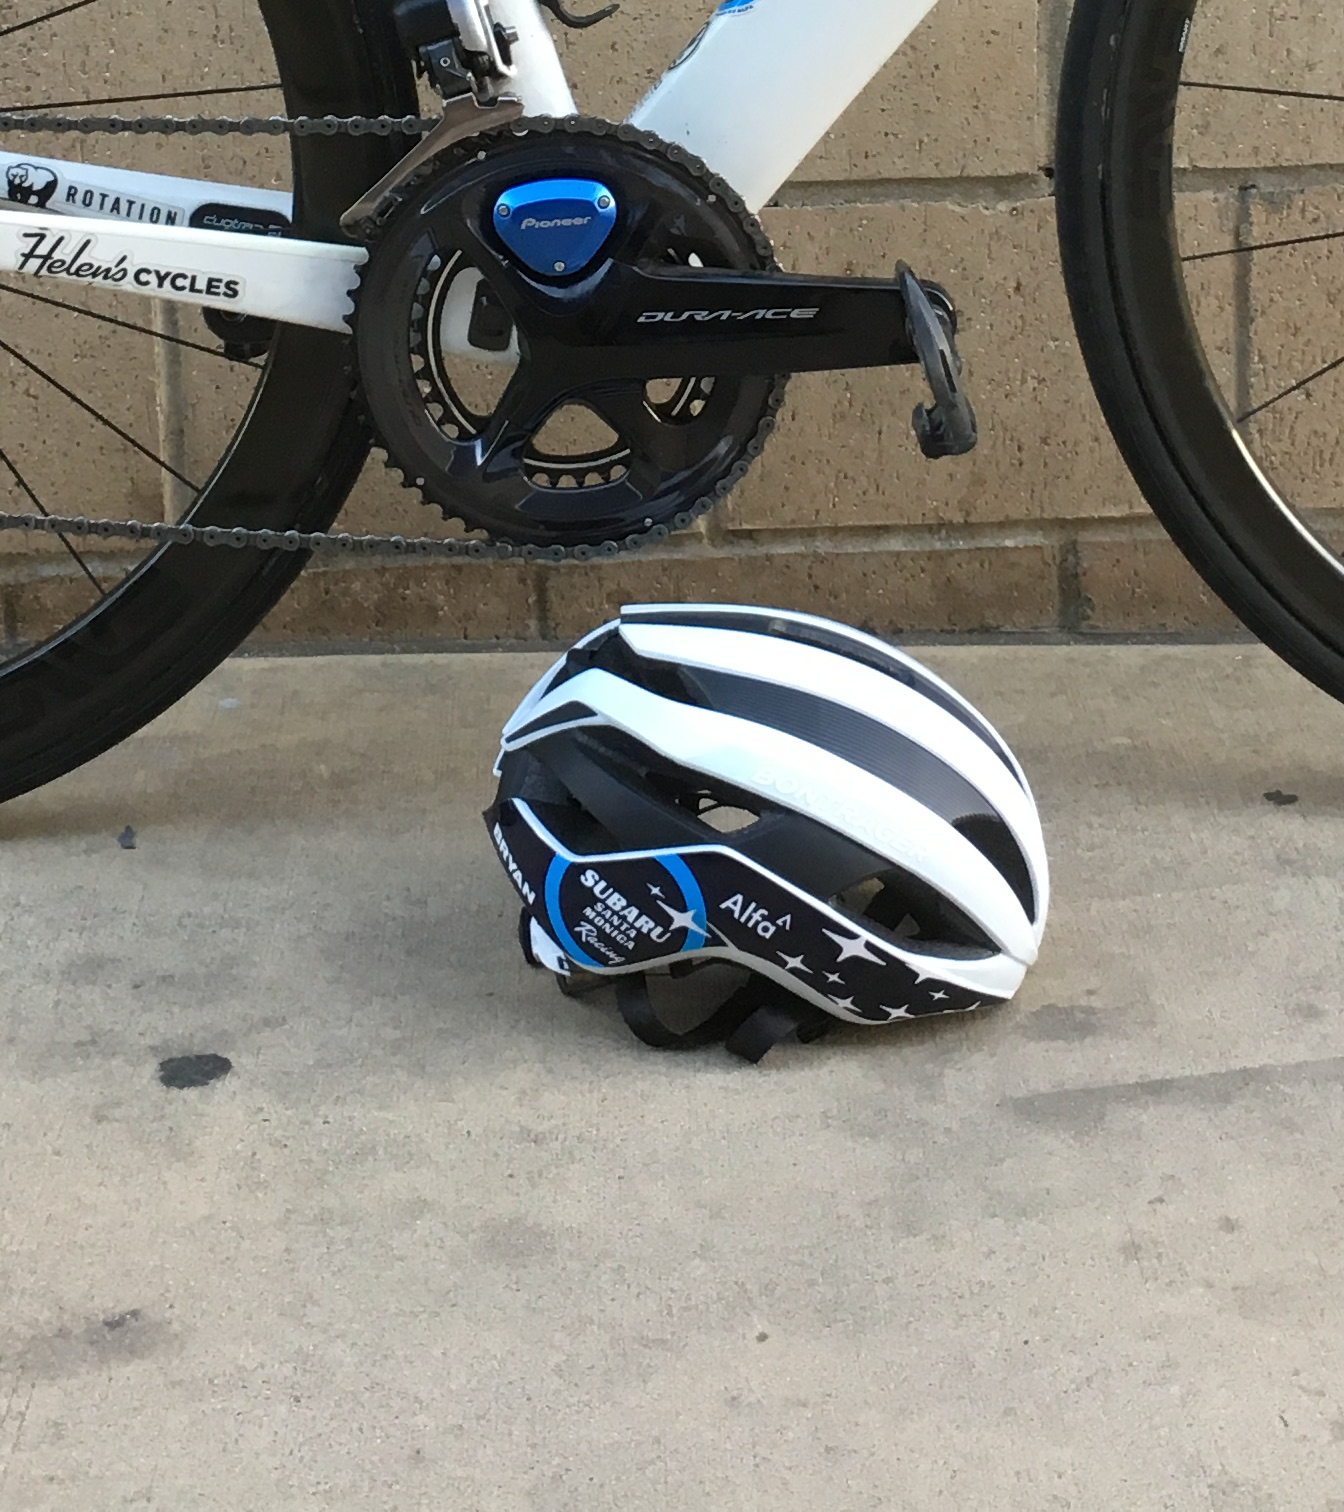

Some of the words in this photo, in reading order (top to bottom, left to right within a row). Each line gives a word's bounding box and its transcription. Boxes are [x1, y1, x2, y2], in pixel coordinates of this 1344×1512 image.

[65, 185, 178, 226] ROTATION
[520, 216, 592, 230] Pioneer
[18, 232, 128, 283] Helen's
[133, 267, 240, 299] CYCLES
[637, 307, 820, 323] DURA-ACE
[751, 765, 927, 863] BONTRAGER
[493, 821, 536, 906] BRYAN
[579, 868, 672, 943] SUBARU
[593, 902, 638, 938] SANTA
[574, 920, 626, 965] Racing
[582, 906, 636, 950] MONICA
